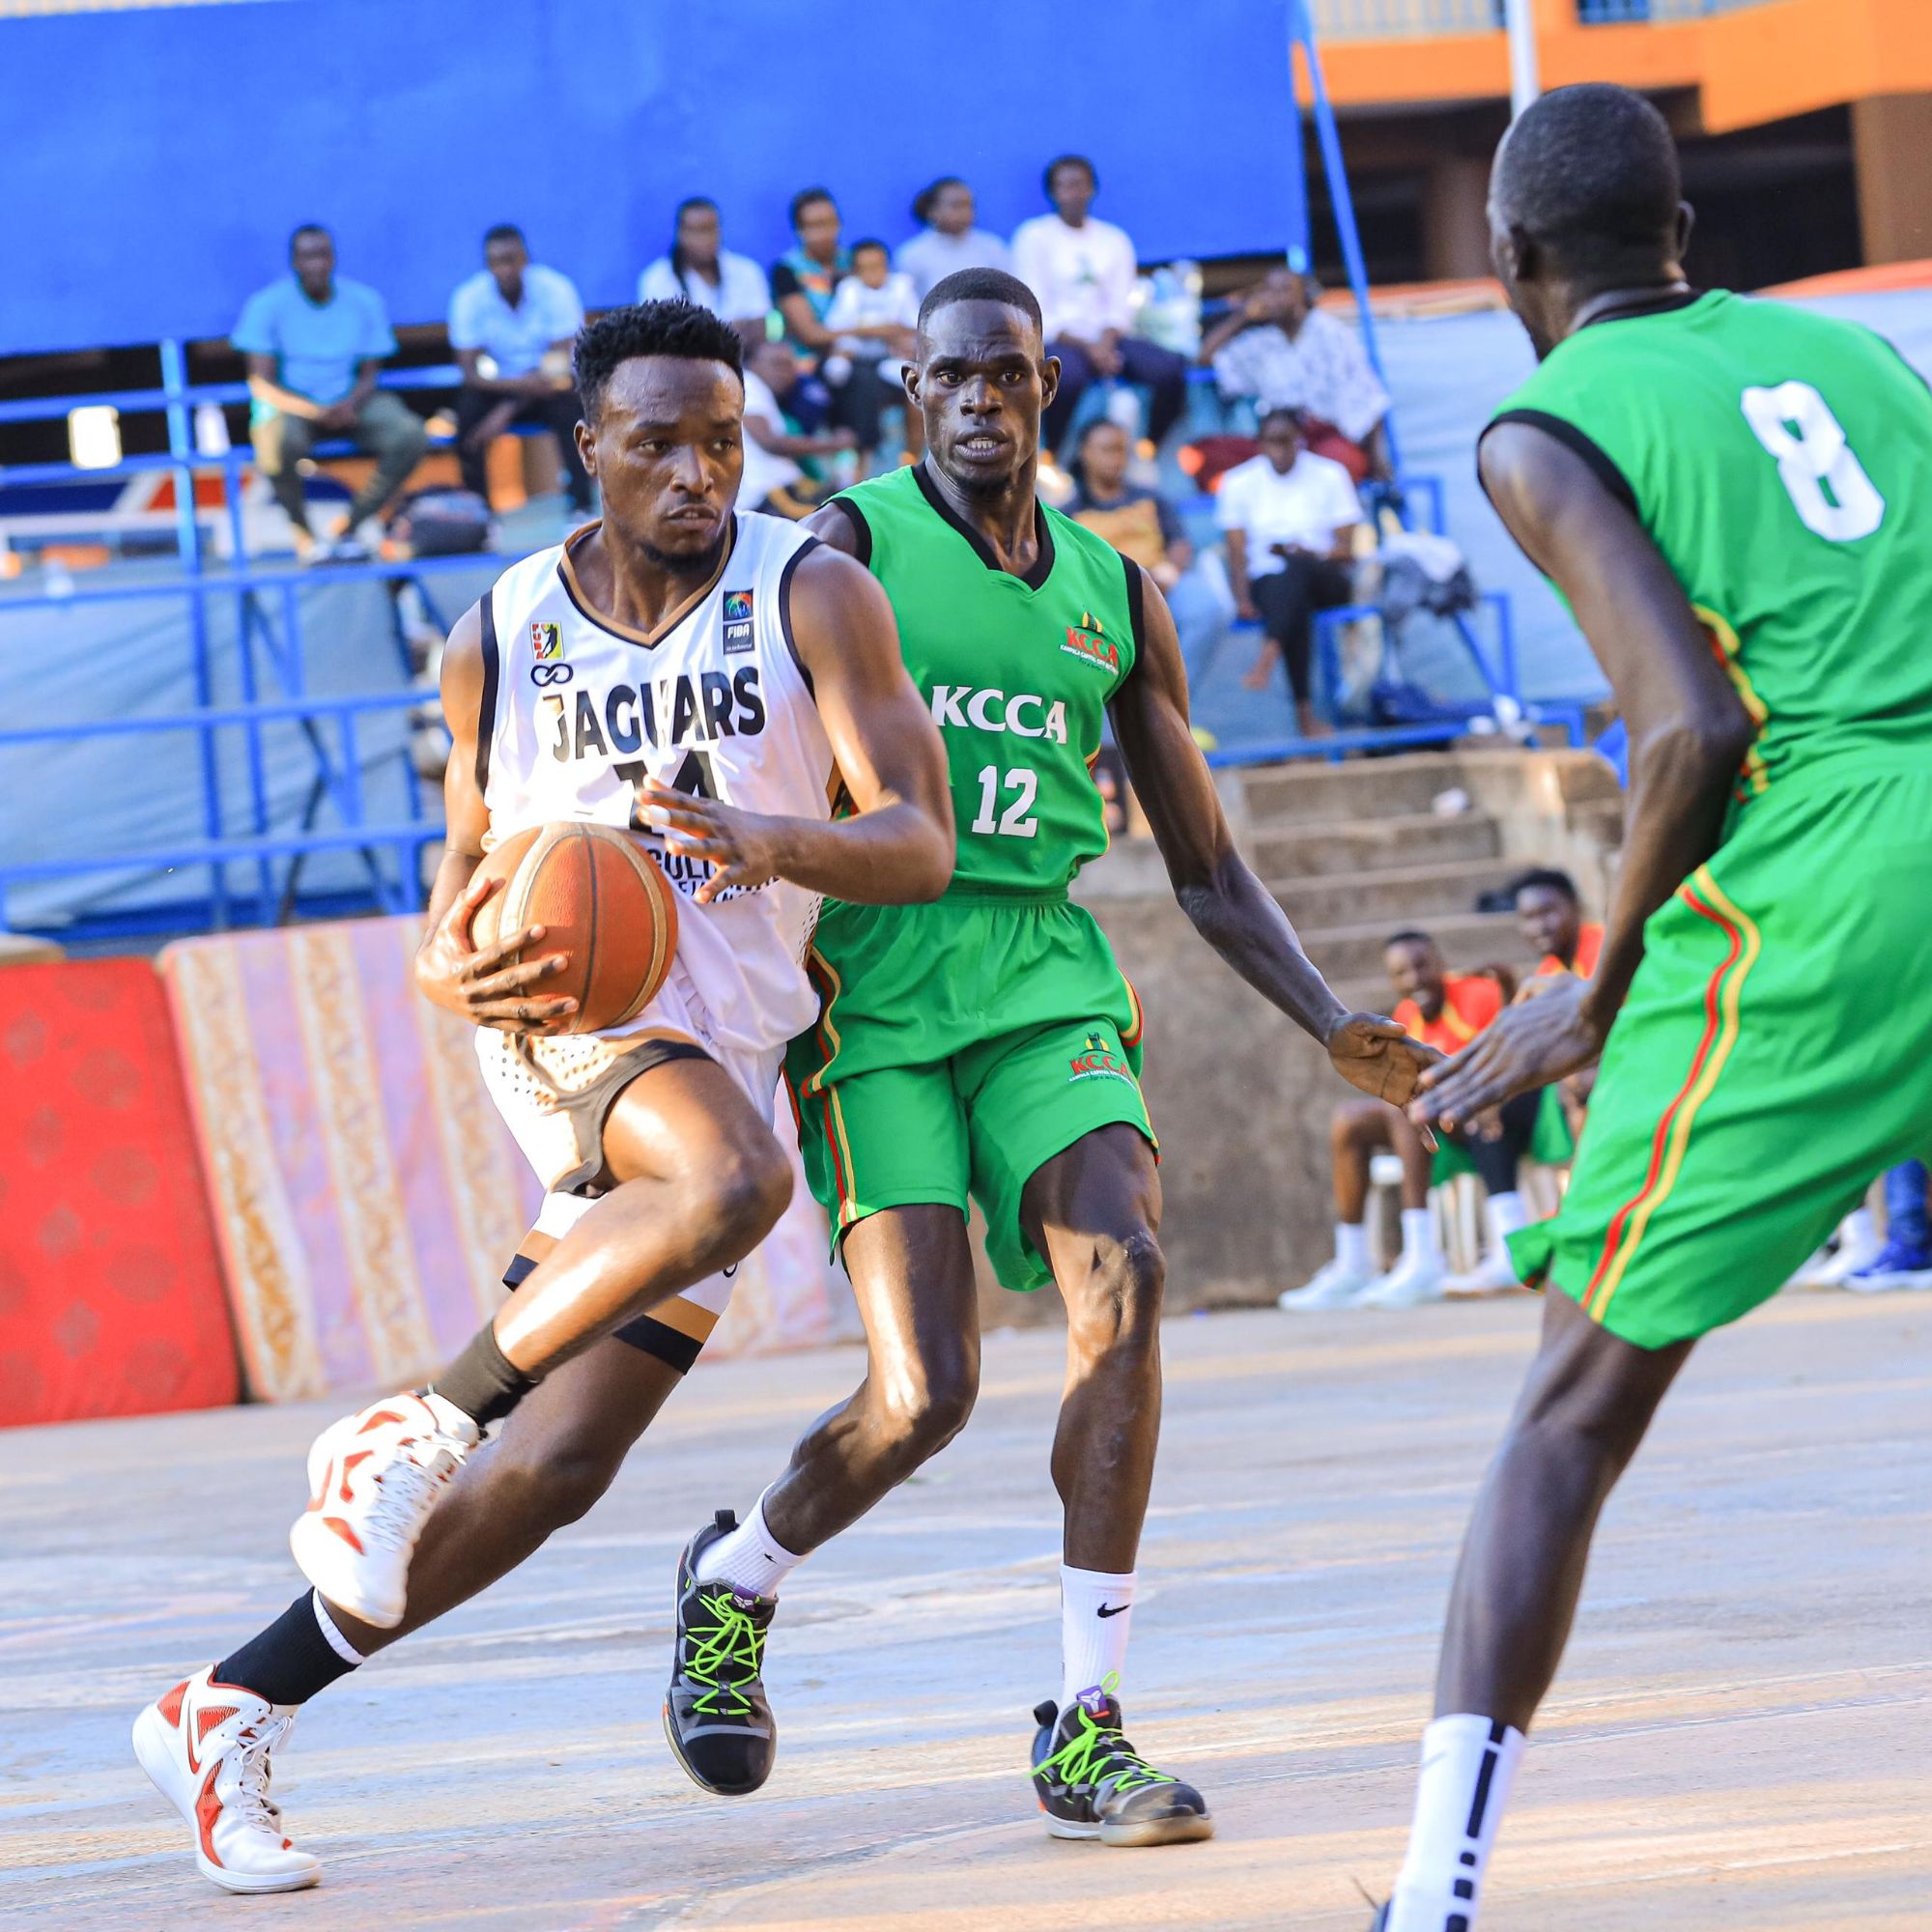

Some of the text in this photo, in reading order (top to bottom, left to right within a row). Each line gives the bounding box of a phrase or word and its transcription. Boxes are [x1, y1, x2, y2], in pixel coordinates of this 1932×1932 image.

[1740, 380, 1886, 542] 8
[726, 623, 751, 639] FIBA
[1065, 626, 1119, 668] KCCA
[542, 666, 766, 764] JAGUARS
[930, 684, 1067, 745] KCCA
[971, 764, 1038, 838] 12
